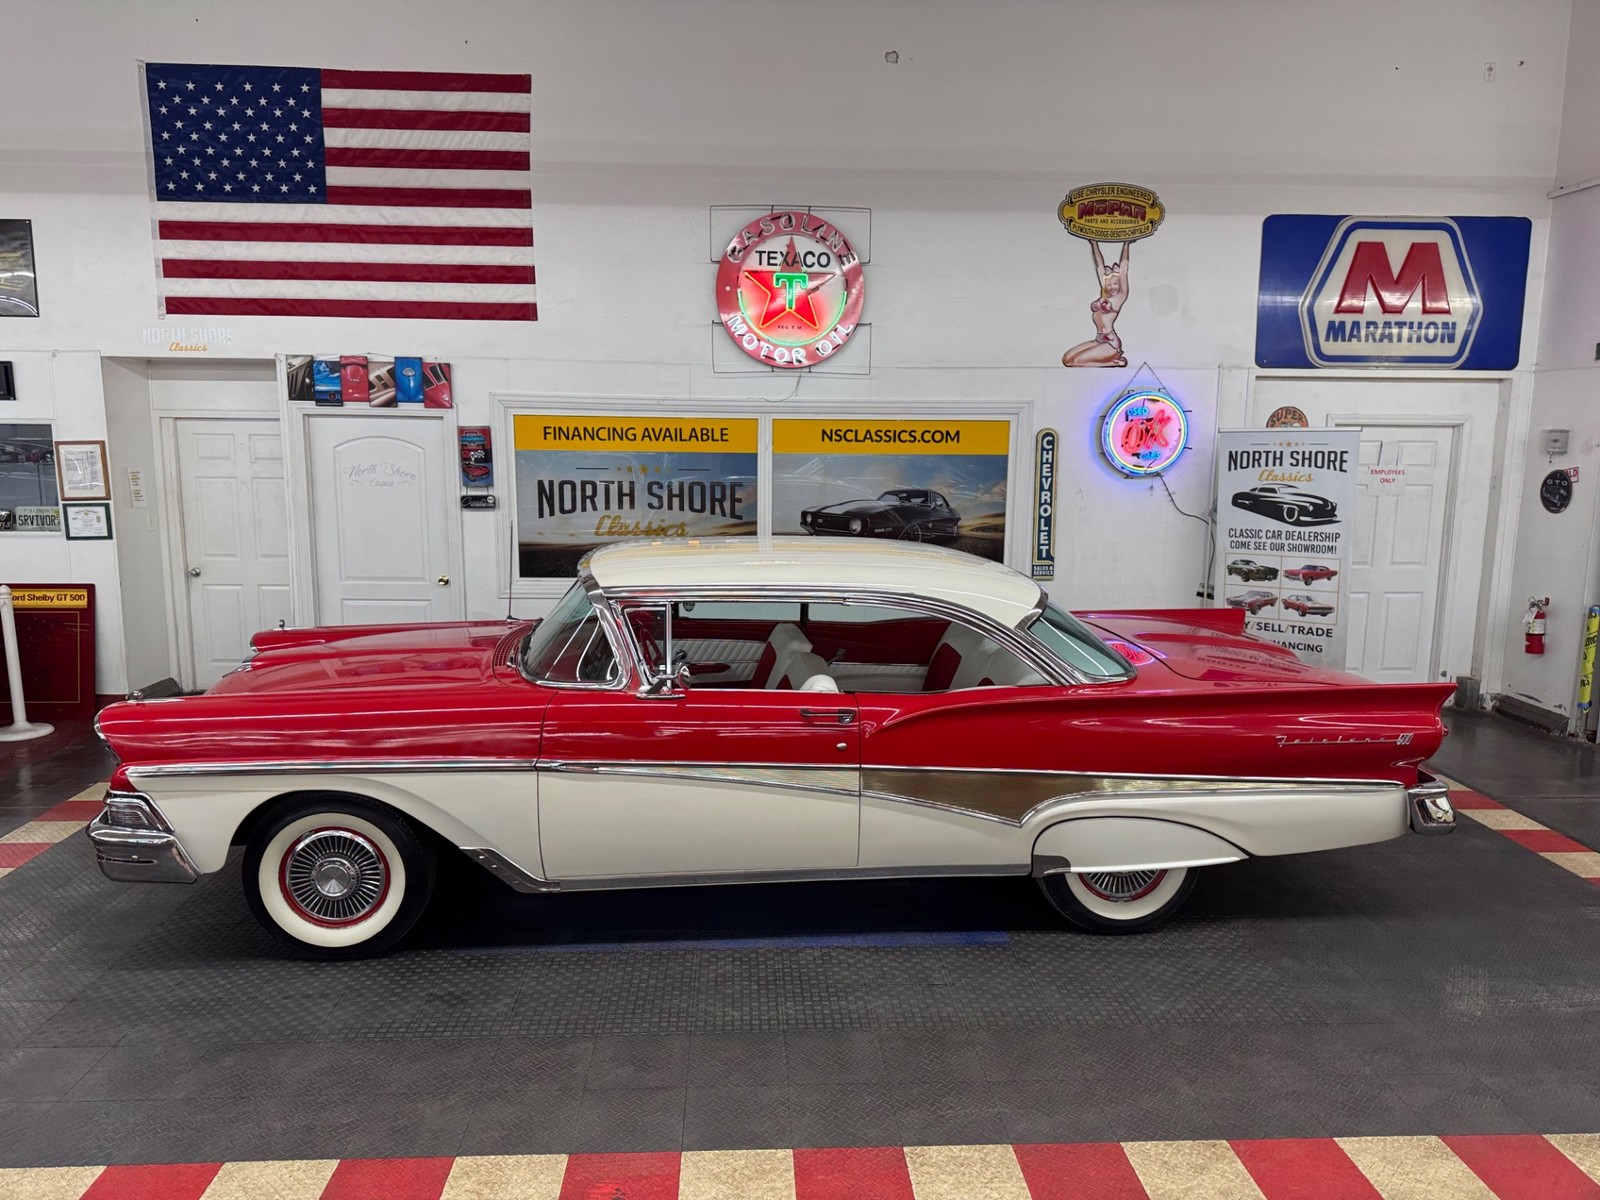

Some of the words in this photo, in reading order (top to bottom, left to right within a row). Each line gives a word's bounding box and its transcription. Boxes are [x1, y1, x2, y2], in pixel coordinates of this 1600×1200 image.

[1073, 189, 1085, 200] USE
[1085, 186, 1115, 197] CHRYSLER
[1116, 186, 1152, 201] ENGINEERED
[1077, 199, 1147, 222] MOPAR
[727, 213, 857, 266] GASOLINE
[755, 250, 831, 268] TEXACO
[1332, 241, 1452, 315] M
[773, 272, 808, 310] T
[727, 314, 807, 366] MOTOR
[815, 324, 854, 356] OIL
[1324, 320, 1457, 344] MARATHON
[169, 341, 208, 352] Classics
[1128, 406, 1149, 416] USED
[543, 426, 637, 442] FINANCING
[641, 427, 729, 442] AVAILABLE
[821, 428, 960, 444] NSCLASSICS.COM
[1121, 409, 1172, 454] OK
[1228, 450, 1284, 472] NORTH
[1289, 450, 1349, 473] SHORE
[1258, 469, 1314, 482] Classics
[537, 479, 636, 519] NORTH
[647, 480, 744, 521] SHORE
[1039, 436, 1054, 559] CHEVROLET
[18, 514, 57, 527] SRVIVOR
[594, 515, 690, 538] Classics
[1228, 528, 1263, 540] CLASSIC
[1265, 529, 1283, 541] CAR
[1285, 530, 1341, 543] DEALERSHIP
[1230, 540, 1252, 550] COME
[1253, 541, 1268, 551] SEE
[1270, 542, 1286, 552] OUR
[1287, 543, 1337, 555] SHOWROOM!
[27, 593, 55, 603] Shelby
[56, 593, 69, 602] GT
[69, 593, 85, 602] 500
